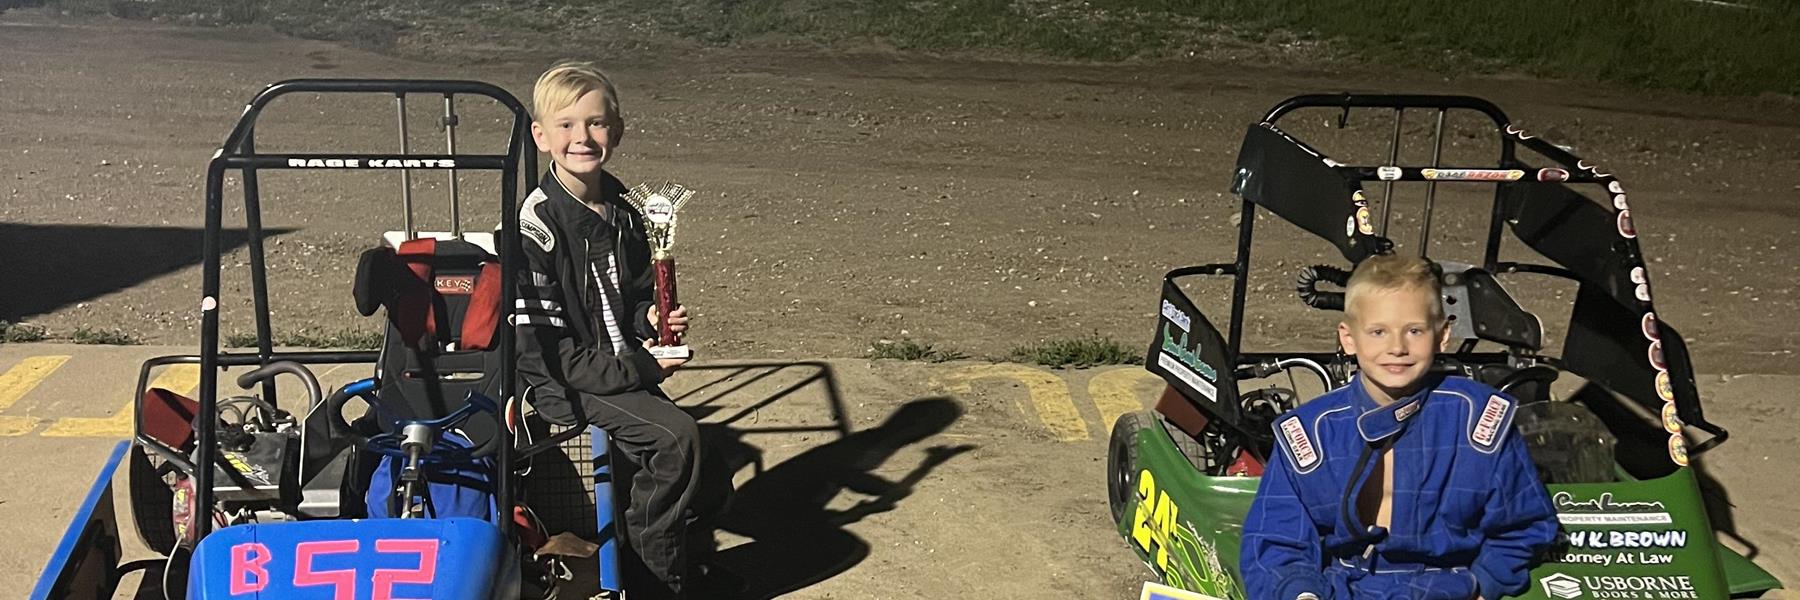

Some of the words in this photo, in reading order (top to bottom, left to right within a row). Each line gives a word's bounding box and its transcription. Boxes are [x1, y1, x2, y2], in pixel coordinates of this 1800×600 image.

[288, 158, 359, 168] RAGE
[368, 159, 456, 168] KARTS
[436, 279, 461, 288] KEY
[1560, 514, 1601, 522] ROPERTY
[1610, 531, 1686, 547] BROWN
[1616, 552, 1635, 564] At
[1640, 552, 1673, 564] Law
[230, 543, 272, 596] B
[1584, 576, 1694, 591] USBORNE
[1592, 591, 1638, 599] BOOKS
[1660, 591, 1698, 599] MORE
